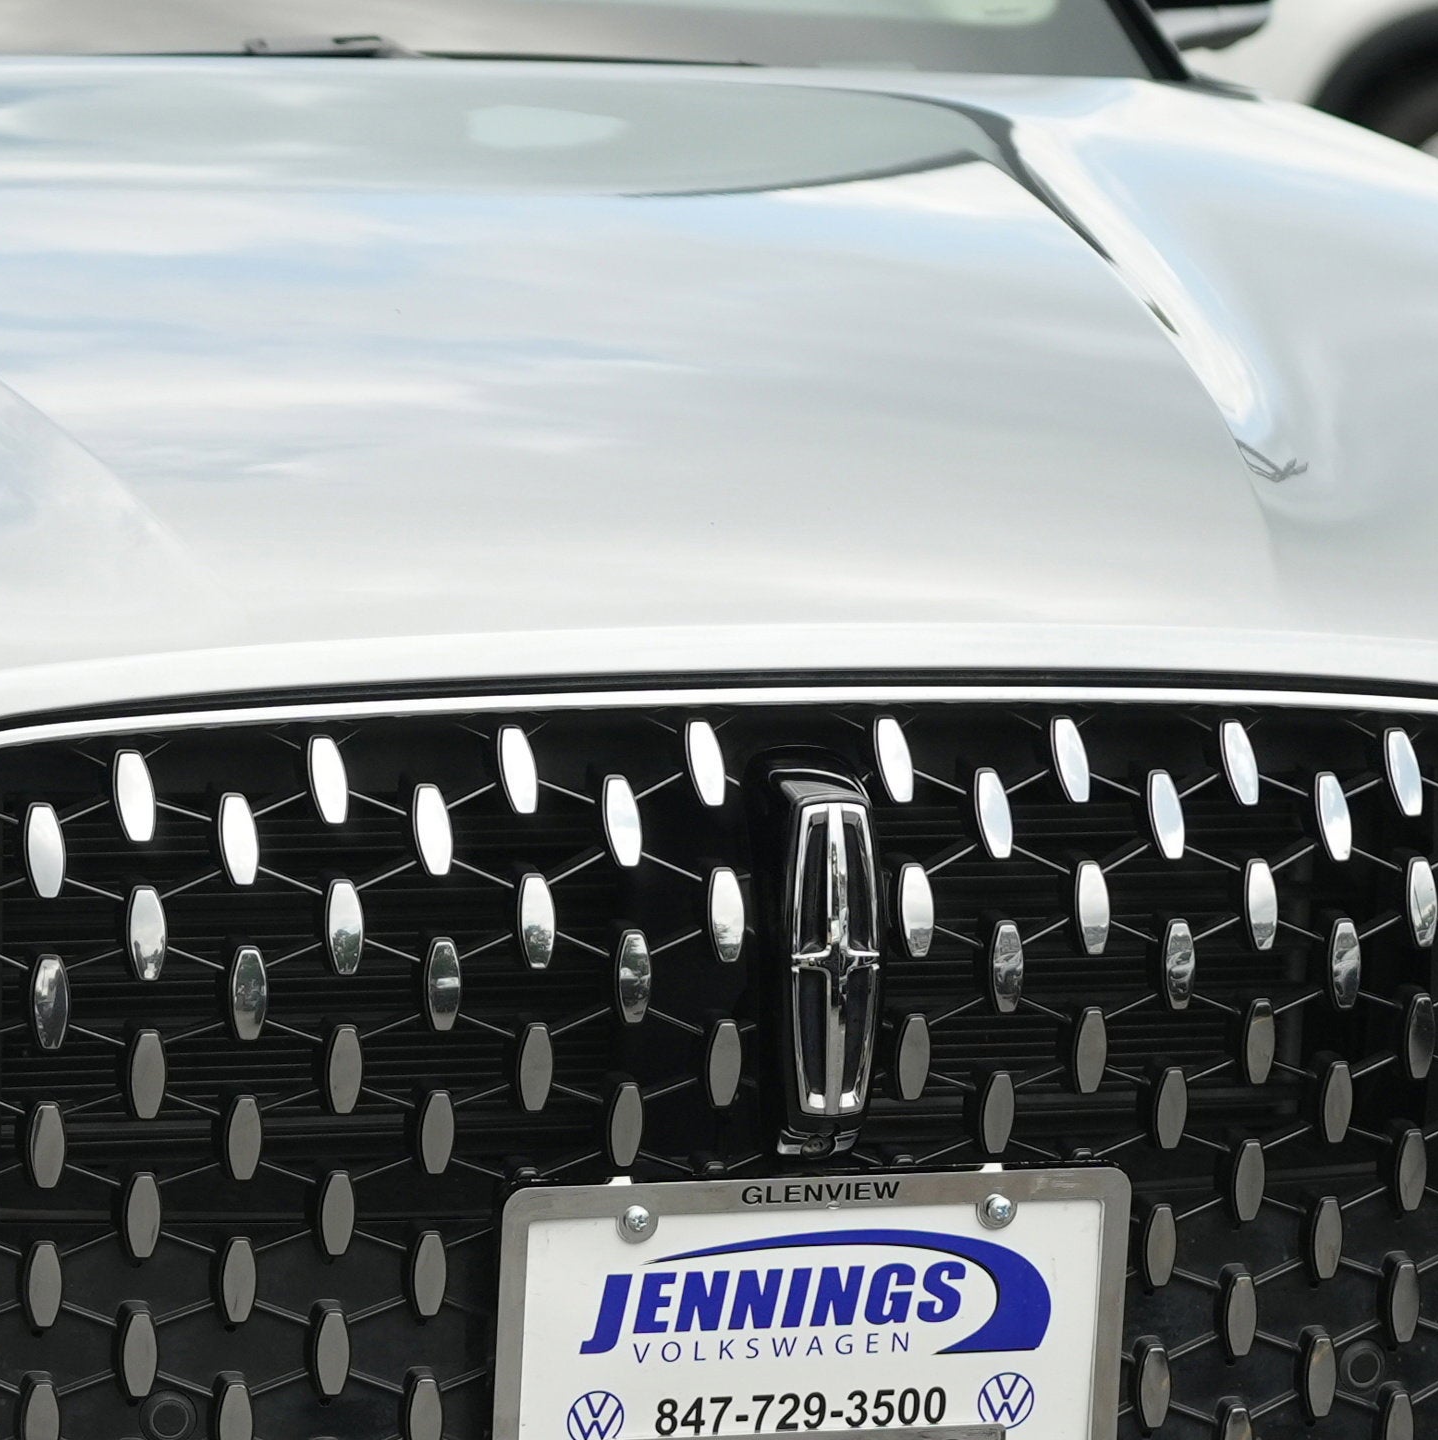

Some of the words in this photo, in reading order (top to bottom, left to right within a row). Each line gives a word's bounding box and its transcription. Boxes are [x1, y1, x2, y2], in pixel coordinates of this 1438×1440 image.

[741, 1181, 901, 1206] GLENVIEW
[579, 1260, 966, 1354] JENNINGS
[633, 1331, 910, 1363] VOLKSWAGEN
[655, 1387, 947, 1436] 847-729-3500
